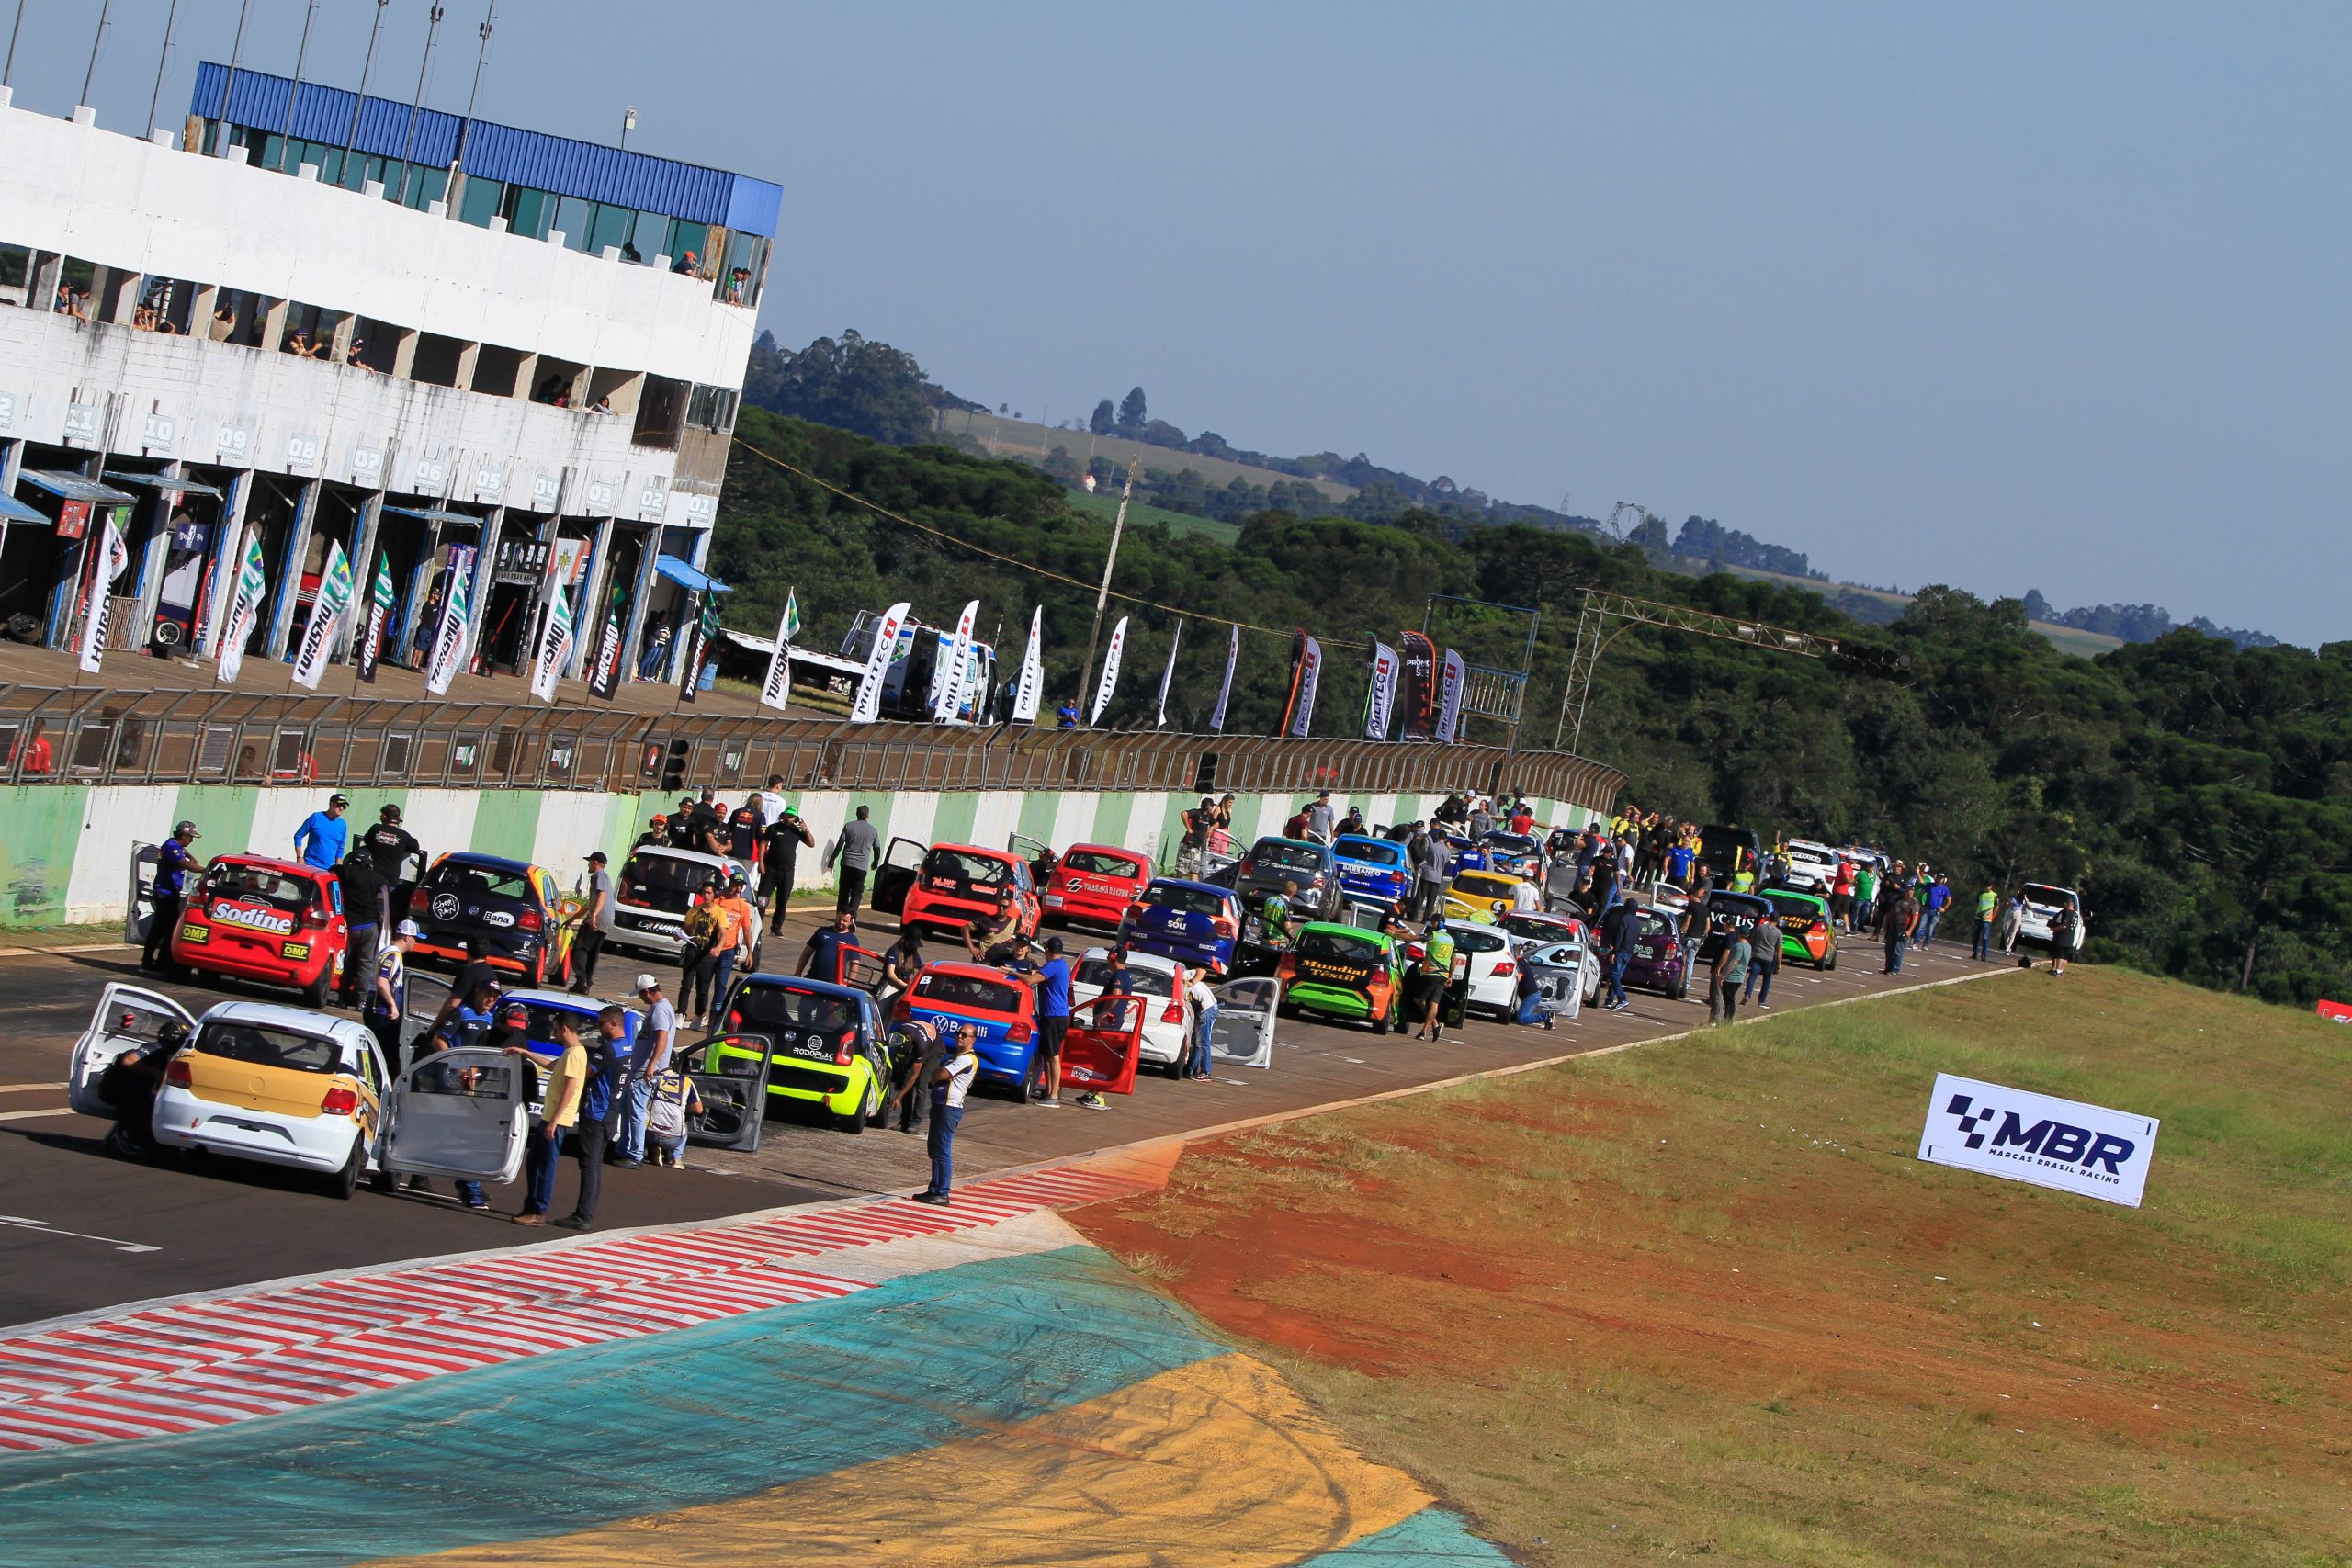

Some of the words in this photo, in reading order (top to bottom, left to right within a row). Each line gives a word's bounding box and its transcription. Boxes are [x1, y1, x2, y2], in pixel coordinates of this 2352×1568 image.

[144, 418, 173, 441] 10
[220, 427, 247, 450] 09
[289, 438, 316, 459] 08
[355, 449, 381, 469] 07
[416, 460, 442, 481] 06
[476, 469, 501, 490] 05
[590, 483, 613, 503] 03
[640, 489, 663, 508] 02
[690, 496, 711, 513] 01
[593, 621, 619, 694] TURISMO
[766, 637, 790, 701] TURISMO
[857, 637, 888, 716] MILITEC
[945, 636, 966, 710] MILITEC
[1020, 639, 1036, 711] MILITEC
[1371, 673, 1385, 732] MILITEC
[213, 903, 292, 933] Sodine
[1167, 919, 1187, 931] sou
[183, 928, 208, 939] OMP
[285, 946, 308, 957] OMP
[1436, 944, 1453, 959] 21
[1301, 959, 1369, 976] Mundial
[920, 976, 933, 985] B
[1991, 1110, 2136, 1176] MBR
[1989, 1148, 2032, 1163] MARCAS
[2037, 1158, 2075, 1174] BRASIL
[2079, 1168, 2120, 1185] RACING
